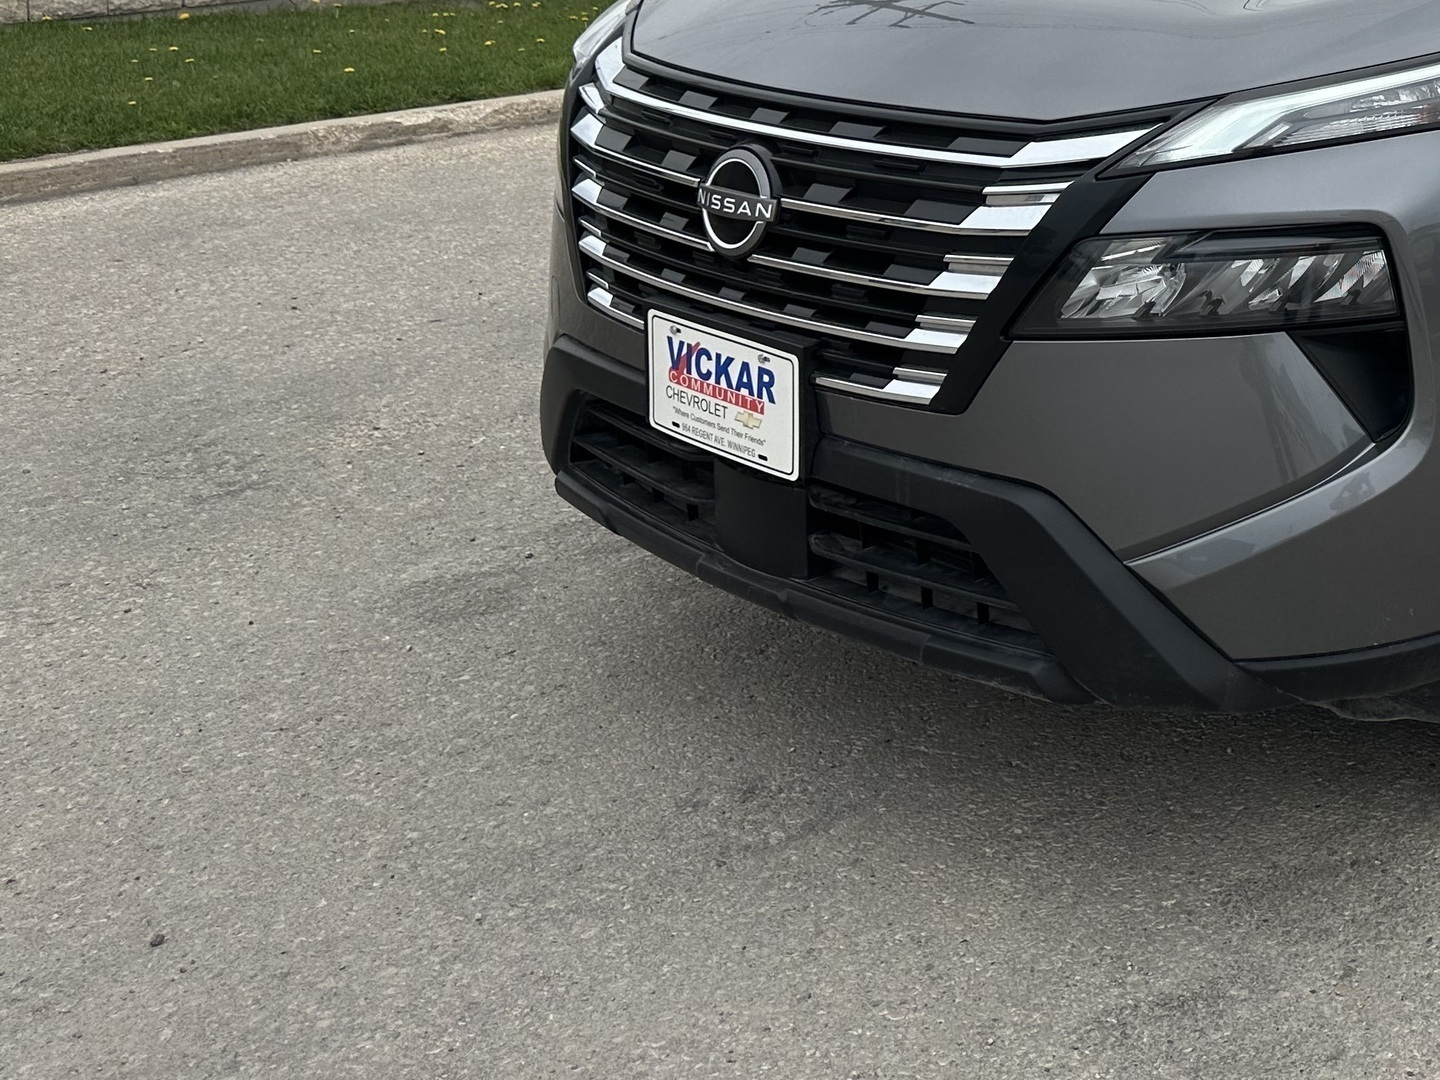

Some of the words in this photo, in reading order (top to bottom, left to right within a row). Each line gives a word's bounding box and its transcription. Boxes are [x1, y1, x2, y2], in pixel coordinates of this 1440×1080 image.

[698, 188, 772, 218] NISSAN
[667, 335, 776, 404] VICKAR
[666, 386, 728, 419] CHEVROLET
[670, 371, 763, 413] COMMUNITY
[691, 413, 716, 428] Customers
[717, 423, 730, 434] Send
[731, 428, 743, 438] Their
[692, 426, 713, 440] REGENT
[727, 440, 756, 458] WINNIPEG
